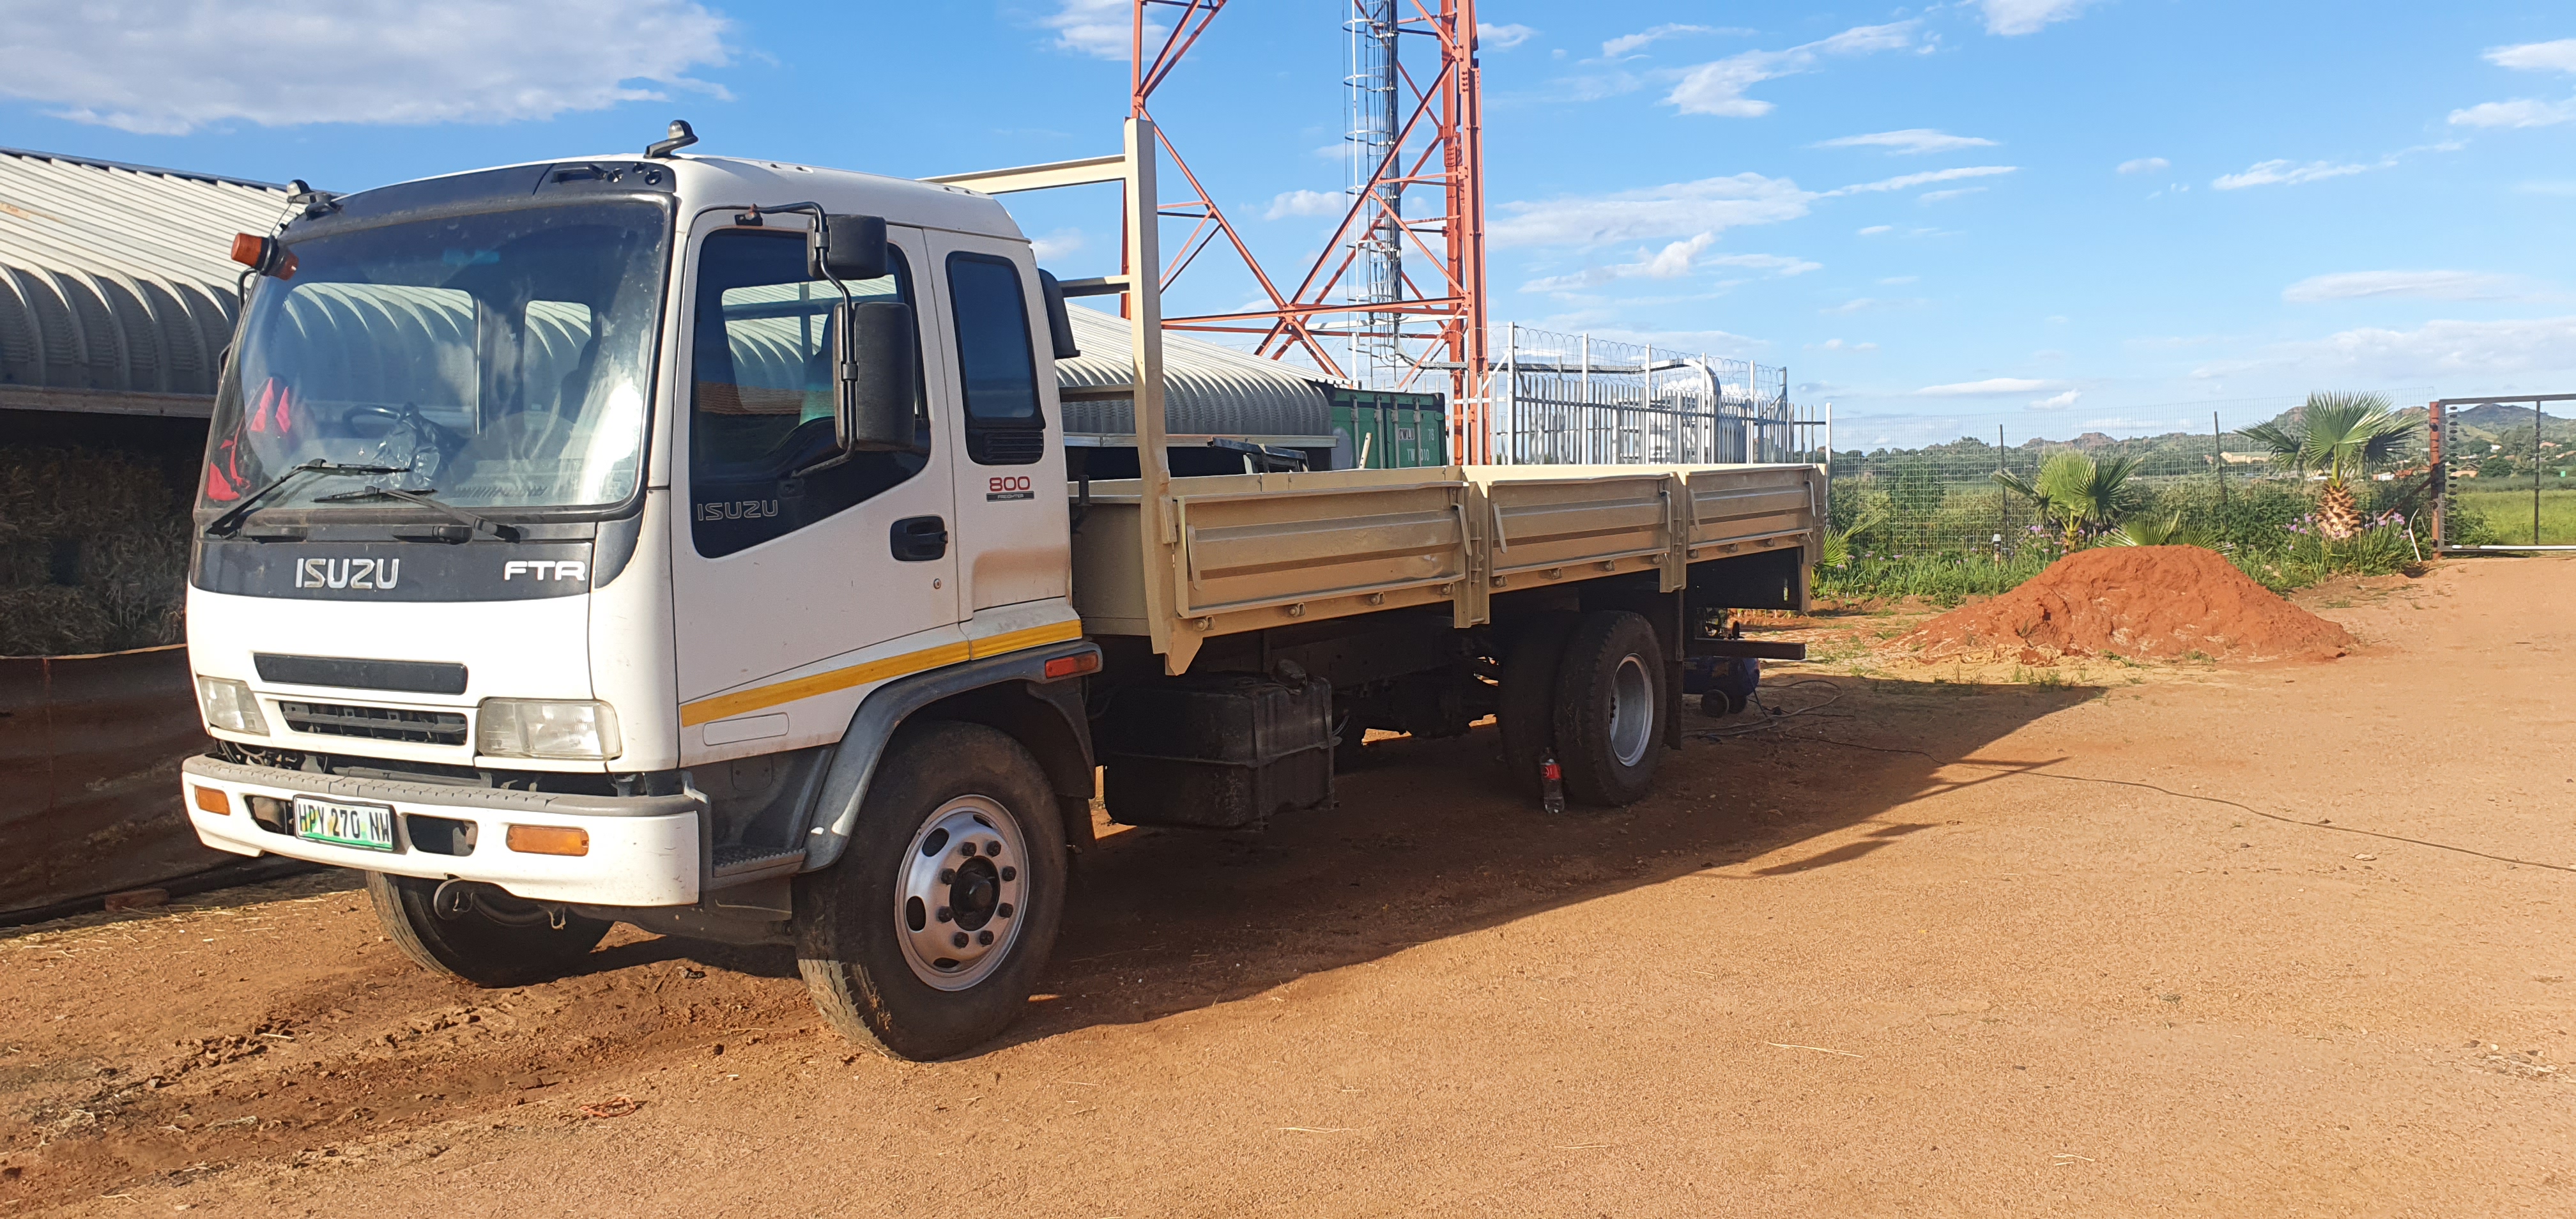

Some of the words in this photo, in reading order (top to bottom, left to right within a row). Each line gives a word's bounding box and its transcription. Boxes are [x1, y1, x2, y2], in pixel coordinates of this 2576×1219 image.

[1399, 429, 1414, 440] CWLU
[989, 475, 1031, 492] 800
[697, 500, 778, 521] ISUZU
[295, 558, 399, 589] ISUZU
[504, 560, 586, 581] FTR
[298, 803, 325, 835] HPY
[330, 808, 361, 839] 270
[369, 811, 390, 842] NW
